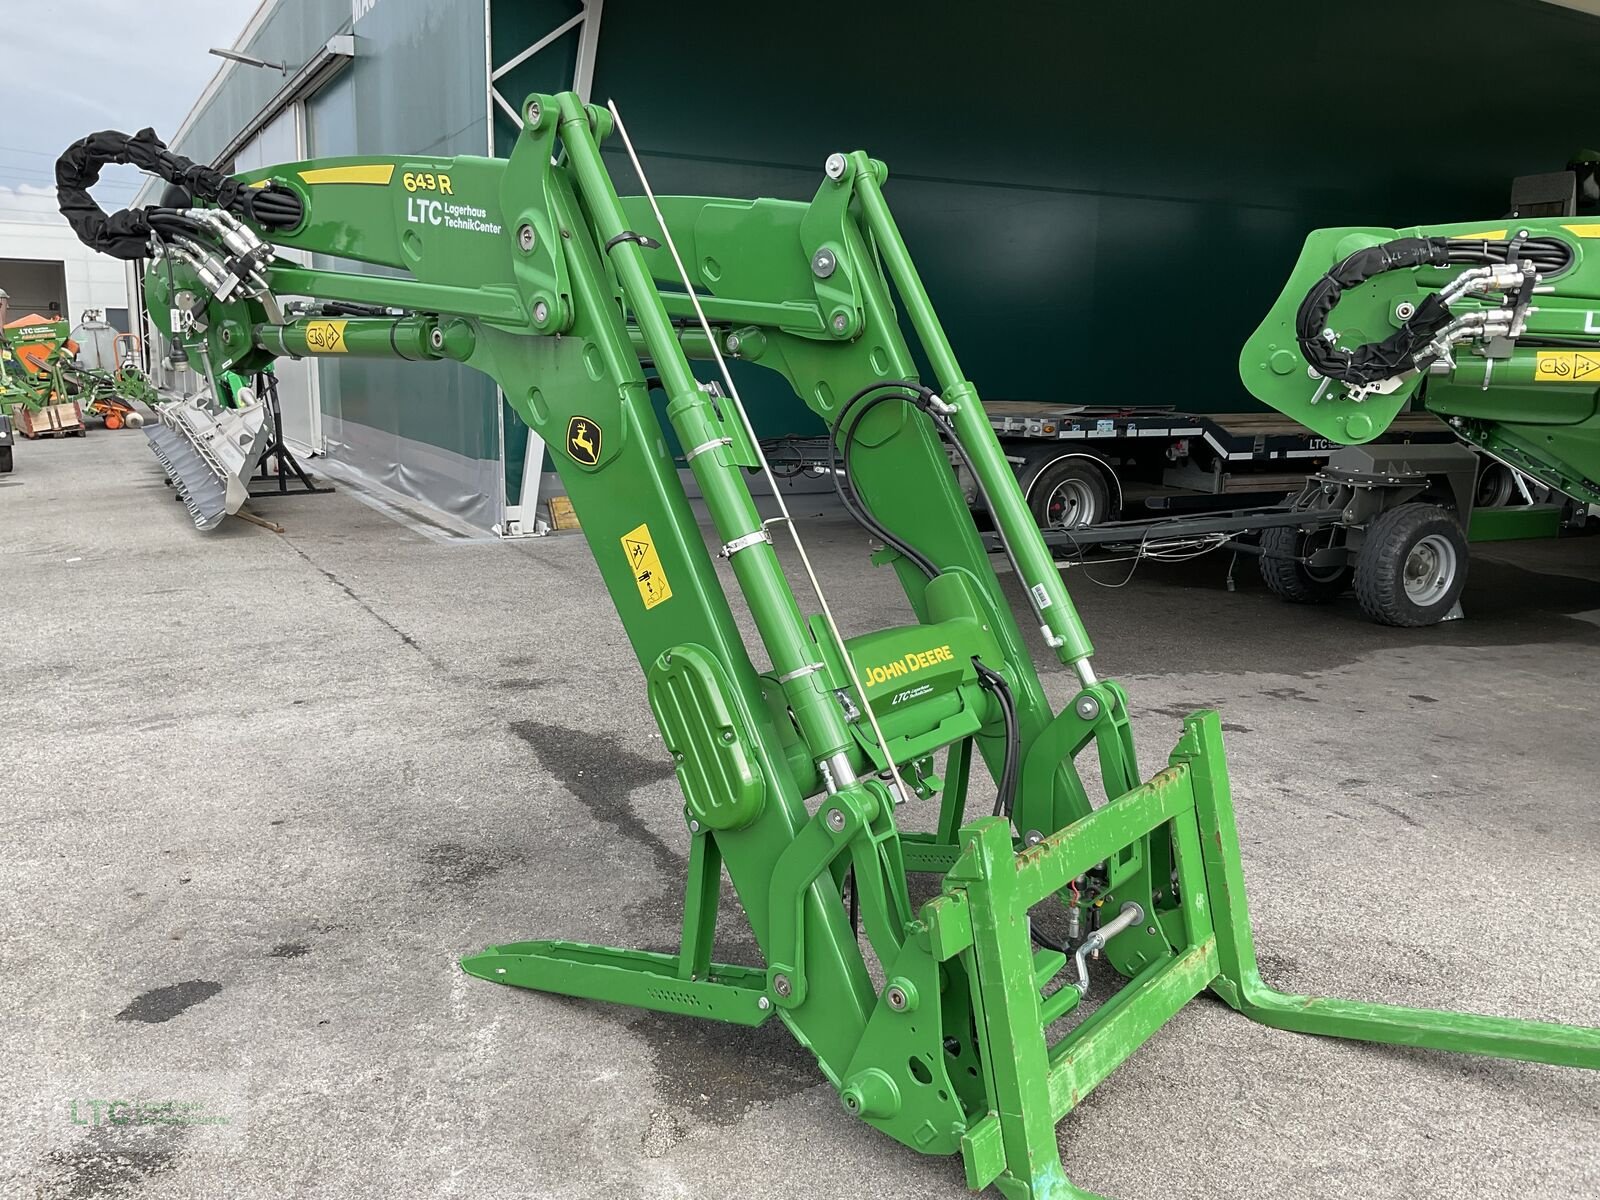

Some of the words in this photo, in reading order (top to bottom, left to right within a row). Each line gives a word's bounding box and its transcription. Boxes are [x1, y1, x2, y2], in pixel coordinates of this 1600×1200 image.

[403, 171, 436, 192] 643
[437, 174, 454, 195] R
[407, 197, 442, 226] LTC
[444, 202, 487, 218] Lagerhaus
[444, 215, 501, 235] TechnikCenter
[1309, 439, 1328, 450] LTC
[865, 659, 909, 688] JOHN
[904, 645, 955, 672] DEERE
[892, 690, 911, 705] LTC
